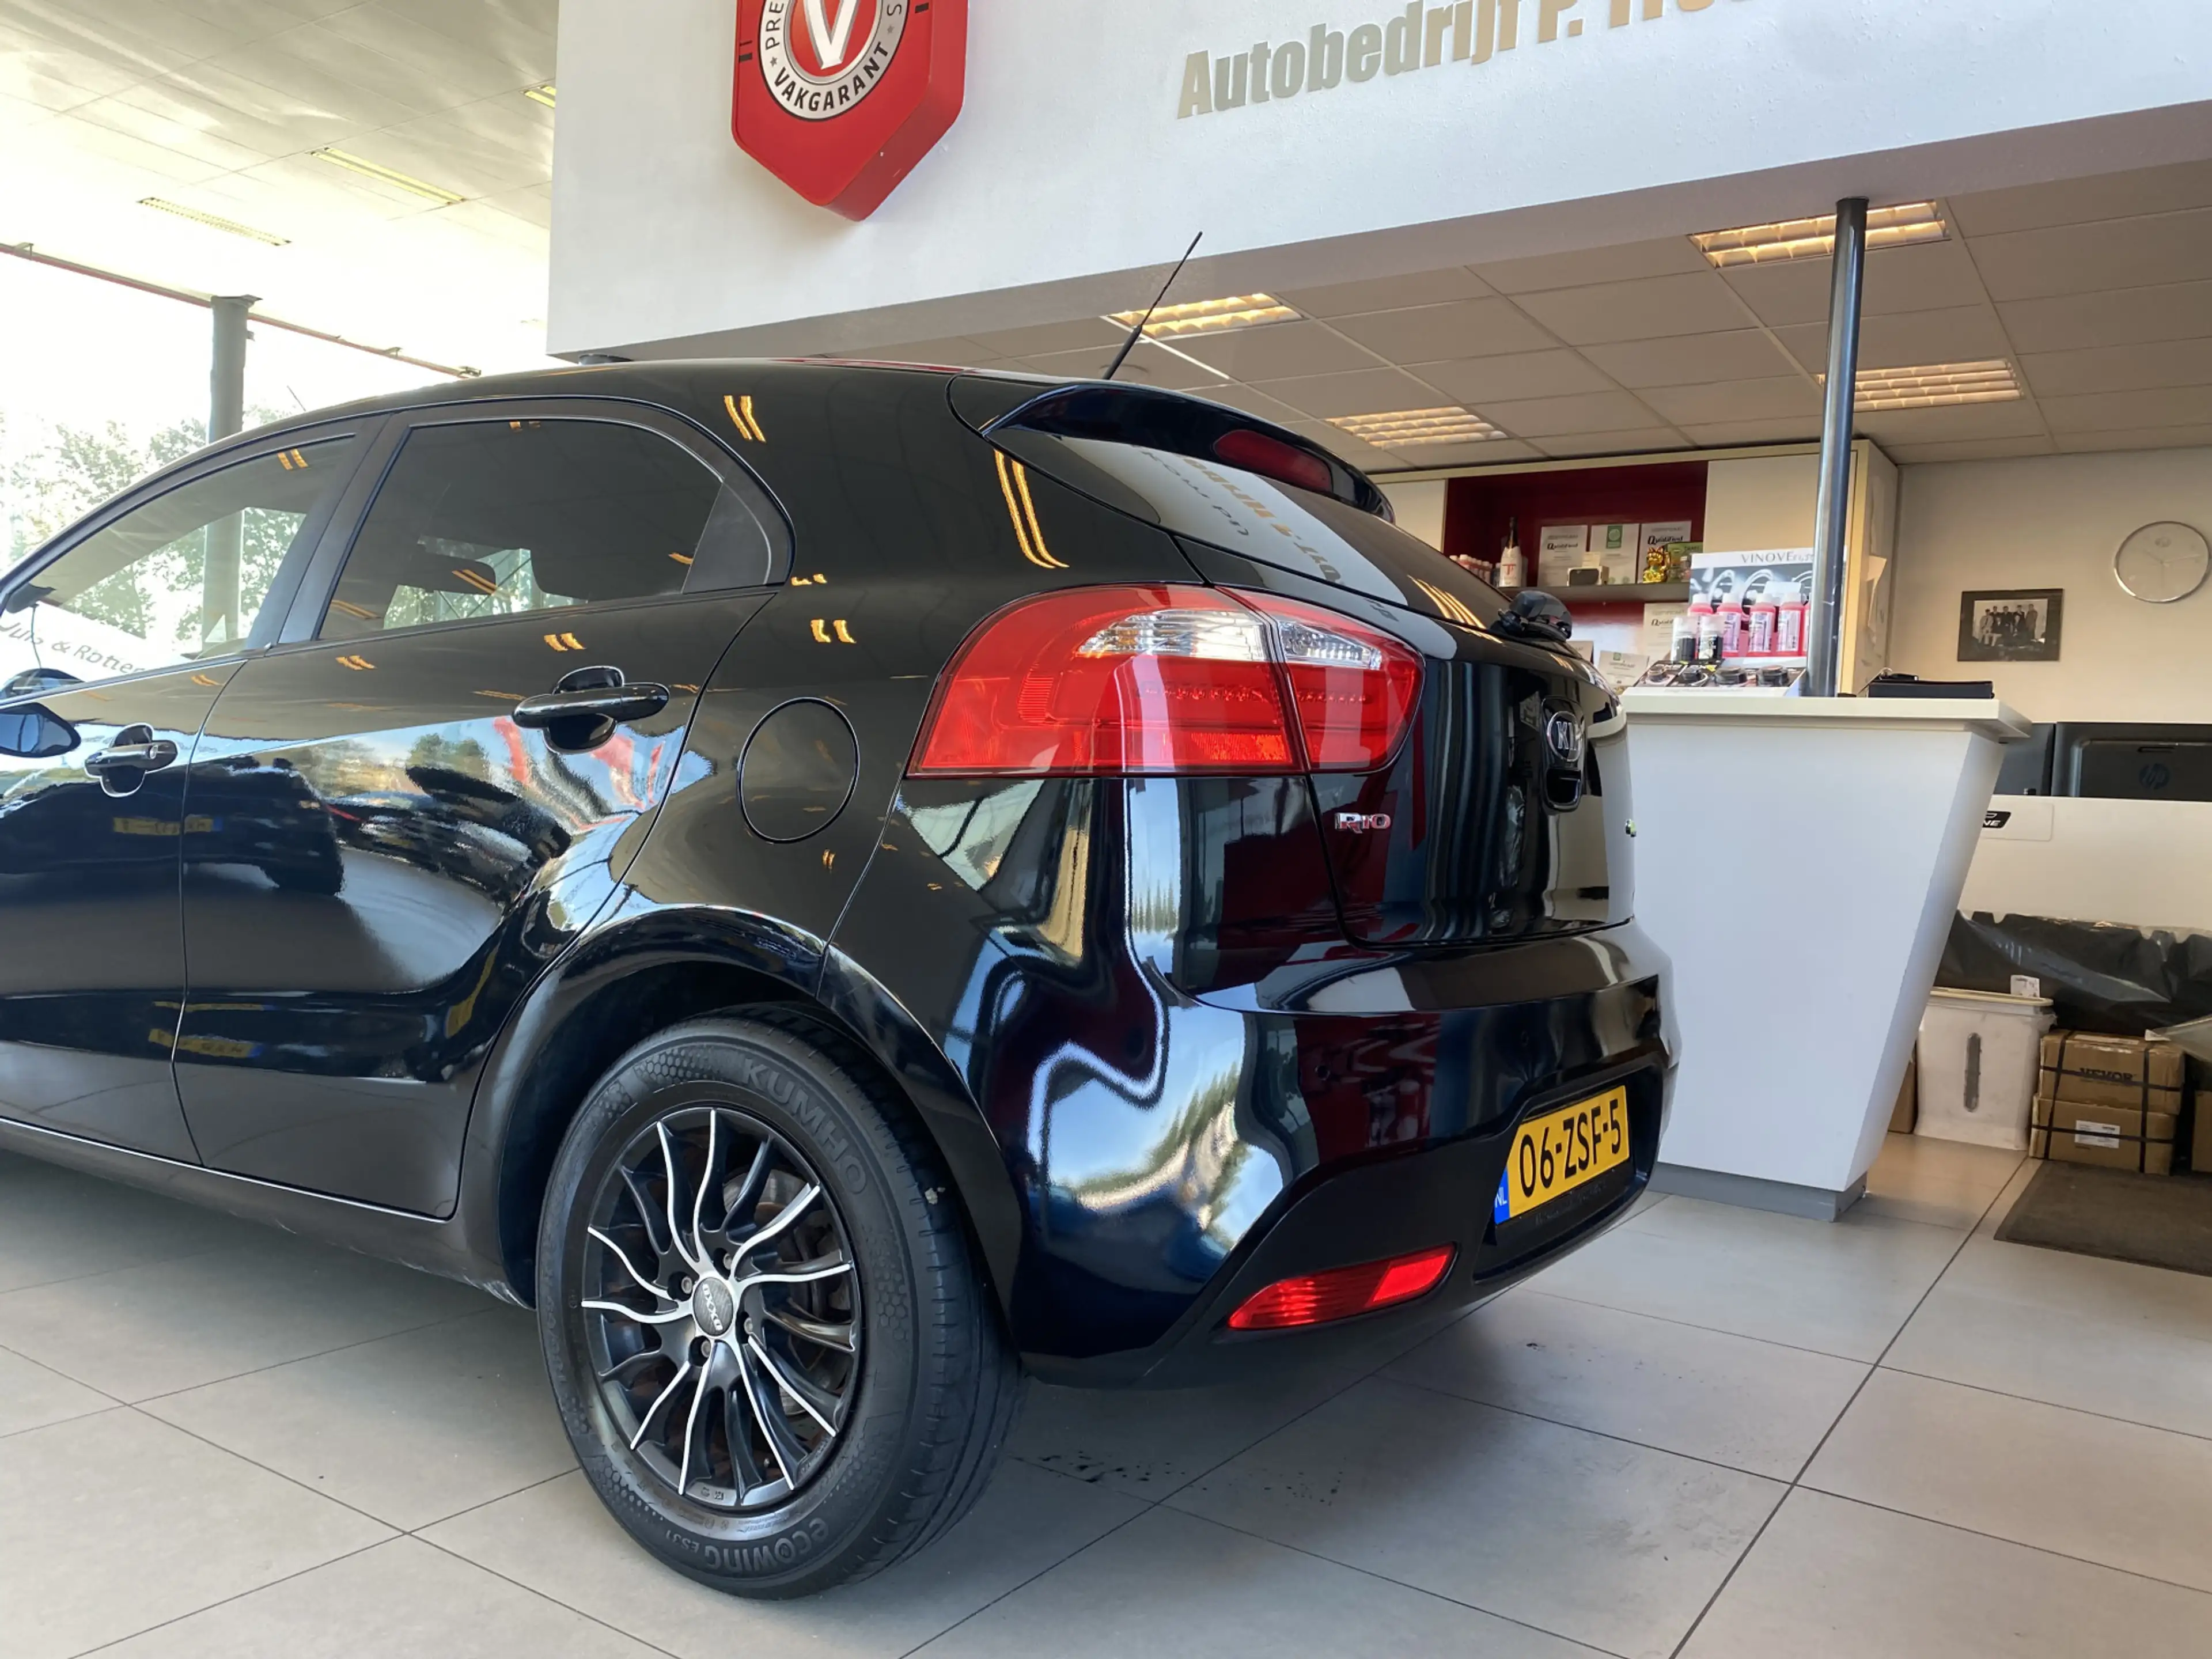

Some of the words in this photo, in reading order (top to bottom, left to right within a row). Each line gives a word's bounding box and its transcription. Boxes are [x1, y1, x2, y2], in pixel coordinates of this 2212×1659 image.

[774, 42, 888, 112] VAKGARANT
[1177, 0, 1521, 119] Autobedrijf
[743, 1058, 866, 1194] KUMHO
[1519, 1099, 1622, 1198] 06-ZSF-5
[1495, 1187, 1508, 1208] NL
